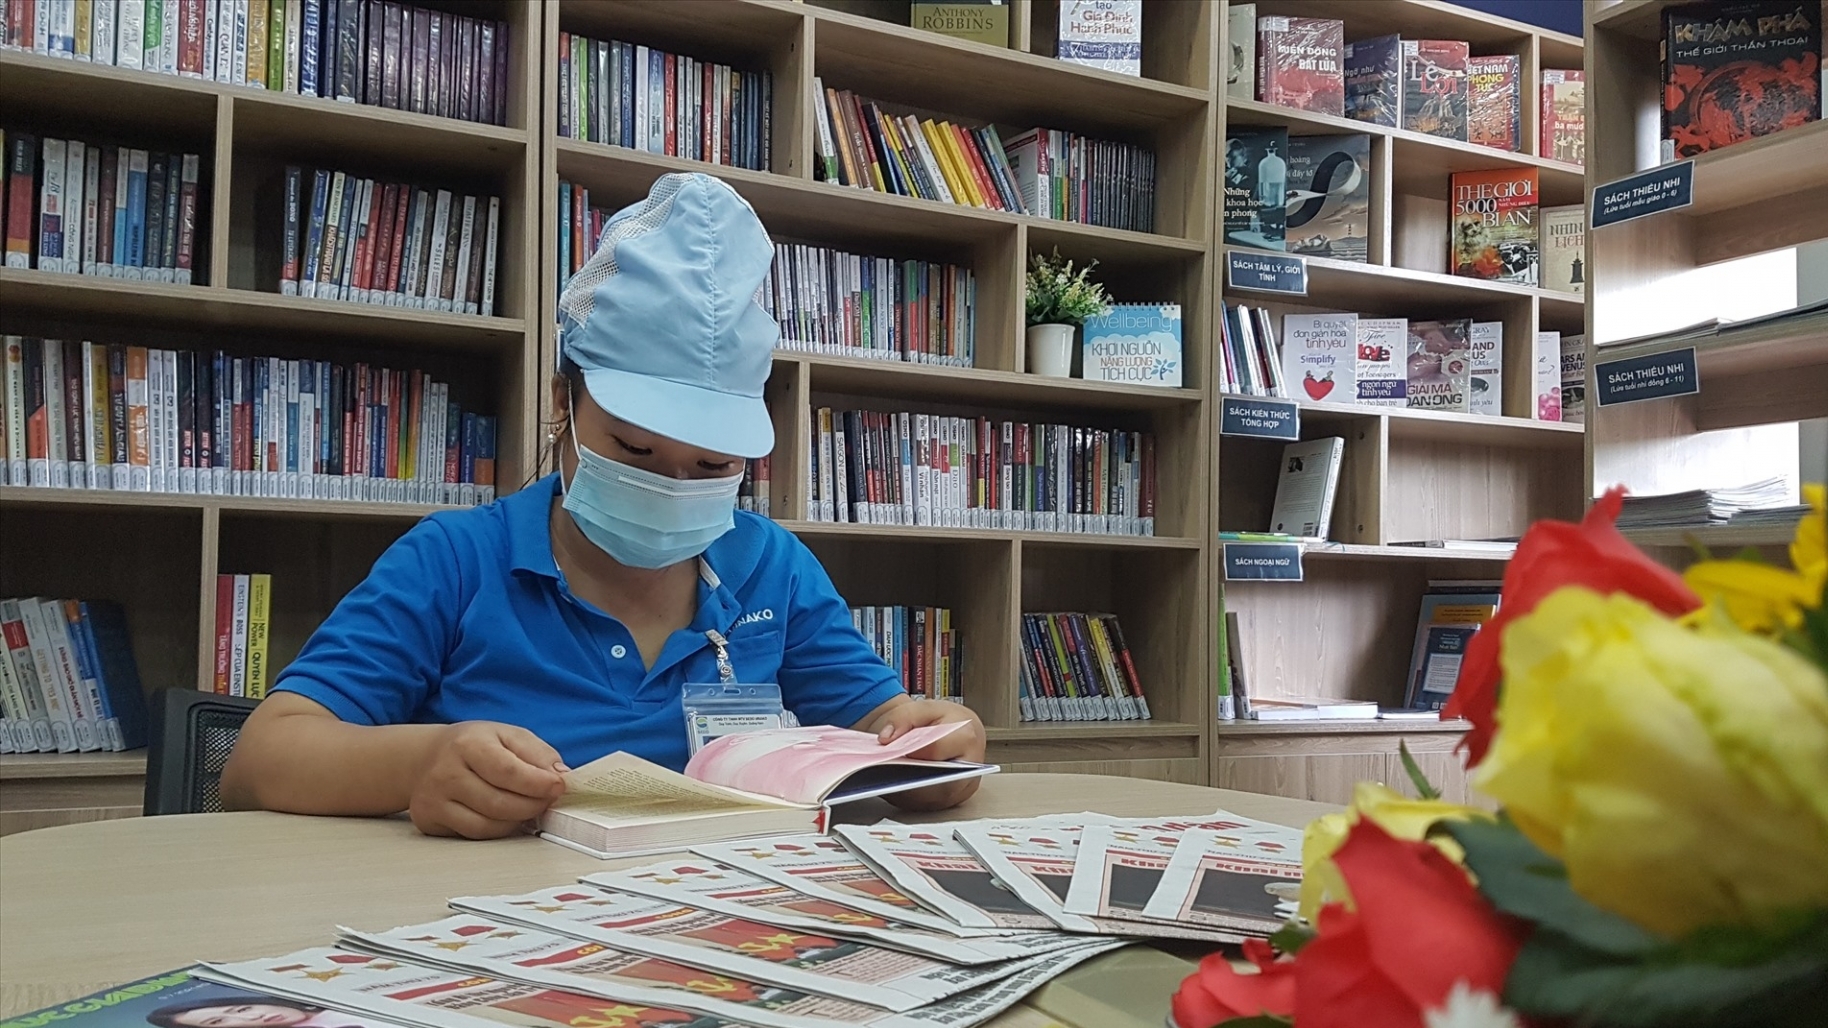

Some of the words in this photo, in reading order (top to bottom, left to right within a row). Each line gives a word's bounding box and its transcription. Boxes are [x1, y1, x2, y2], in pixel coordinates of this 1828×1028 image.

[933, 6, 985, 18] ANTHONY
[922, 16, 994, 30] ROBBINS
[1675, 17, 1752, 45] KHÁM
[1757, 5, 1811, 36] PHÁ
[1676, 41, 1700, 57] THẾ
[1703, 42, 1727, 55] GIỚI
[1731, 39, 1767, 51] THẦN
[1770, 36, 1809, 48] THOẠI
[1410, 60, 1438, 81] Lê
[1484, 63, 1508, 74] NAM
[1420, 72, 1458, 97] Lợi
[1555, 121, 1565, 129] ba
[1567, 122, 1584, 130] mươ
[1604, 190, 1631, 205] SÁCH
[1632, 183, 1661, 197] THIẾU
[1663, 177, 1680, 189] NHI
[1231, 208, 1257, 218] phong
[1456, 198, 1497, 215] 5000
[1233, 260, 1254, 270] SÁCH
[1255, 262, 1270, 272] TÂM
[1272, 264, 1284, 273] LÝ,
[1285, 265, 1300, 274] GIỚI
[1259, 272, 1276, 282] TÍNH
[1090, 314, 1173, 332] Wellbeing
[1100, 356, 1123, 367] NĂNG
[1125, 356, 1152, 368] LƯỢNG
[1300, 354, 1336, 365] Simplify
[1100, 366, 1126, 381] TÍCH
[1128, 366, 1152, 382] CỰC
[1609, 371, 1634, 384] SÁCH
[1636, 365, 1664, 379] THIẾU
[1667, 363, 1684, 374] NHI
[1229, 406, 1250, 416] SÁCH
[1252, 408, 1268, 418] KIẾN
[1270, 410, 1290, 420] THỨC
[1241, 418, 1261, 427] TỔNG
[1263, 420, 1279, 429] HỢP
[836, 437, 845, 467] SAIGON
[1235, 556, 1253, 566] SÁCH
[1254, 557, 1274, 568] NGOẠI
[1275, 556, 1290, 566] NGỮ
[235, 619, 243, 635] BOSS
